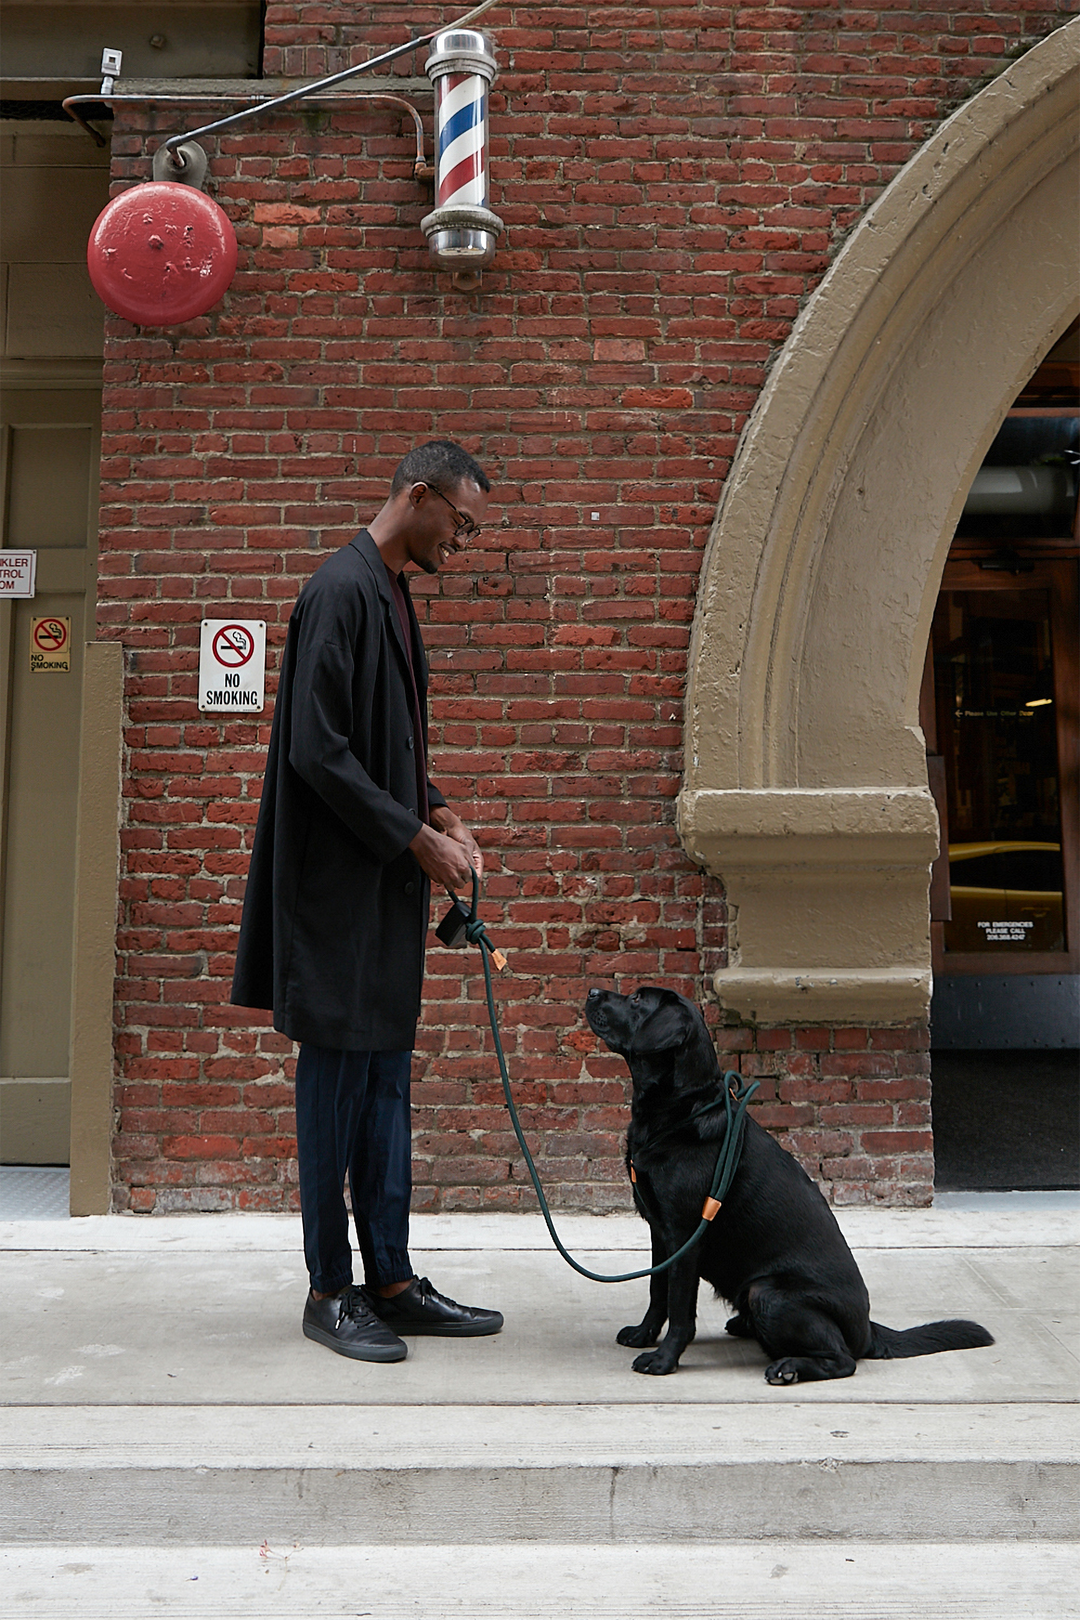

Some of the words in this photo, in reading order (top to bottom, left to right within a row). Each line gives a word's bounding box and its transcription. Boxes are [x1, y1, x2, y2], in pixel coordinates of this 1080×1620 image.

[31, 654, 44, 662] NO
[31, 661, 68, 669] SMOKING
[224, 673, 240, 688] NO
[206, 690, 258, 706] SMOKING
